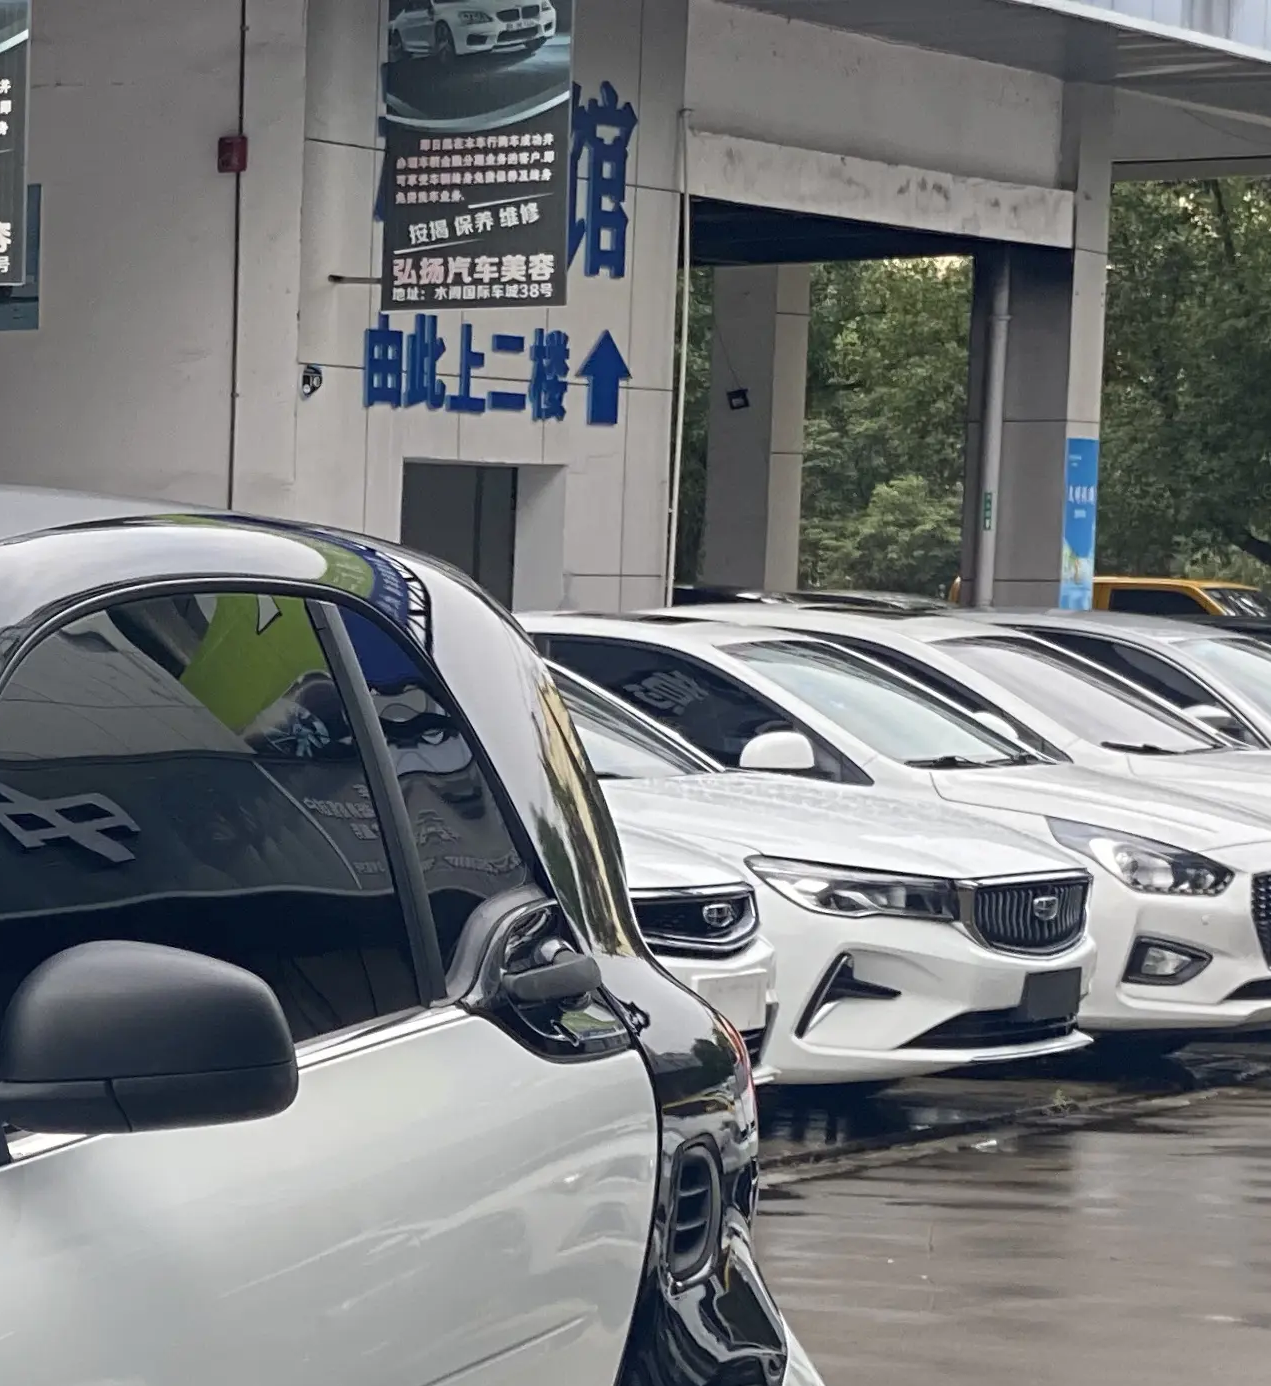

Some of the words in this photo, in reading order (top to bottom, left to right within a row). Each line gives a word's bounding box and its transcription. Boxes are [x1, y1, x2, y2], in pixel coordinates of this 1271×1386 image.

[408, 218, 450, 245] 按揭
[453, 210, 494, 237] 保养
[498, 202, 540, 228] 维修
[392, 253, 555, 286] 弘扬汽车美容
[363, 312, 570, 422] 由此上二楼
